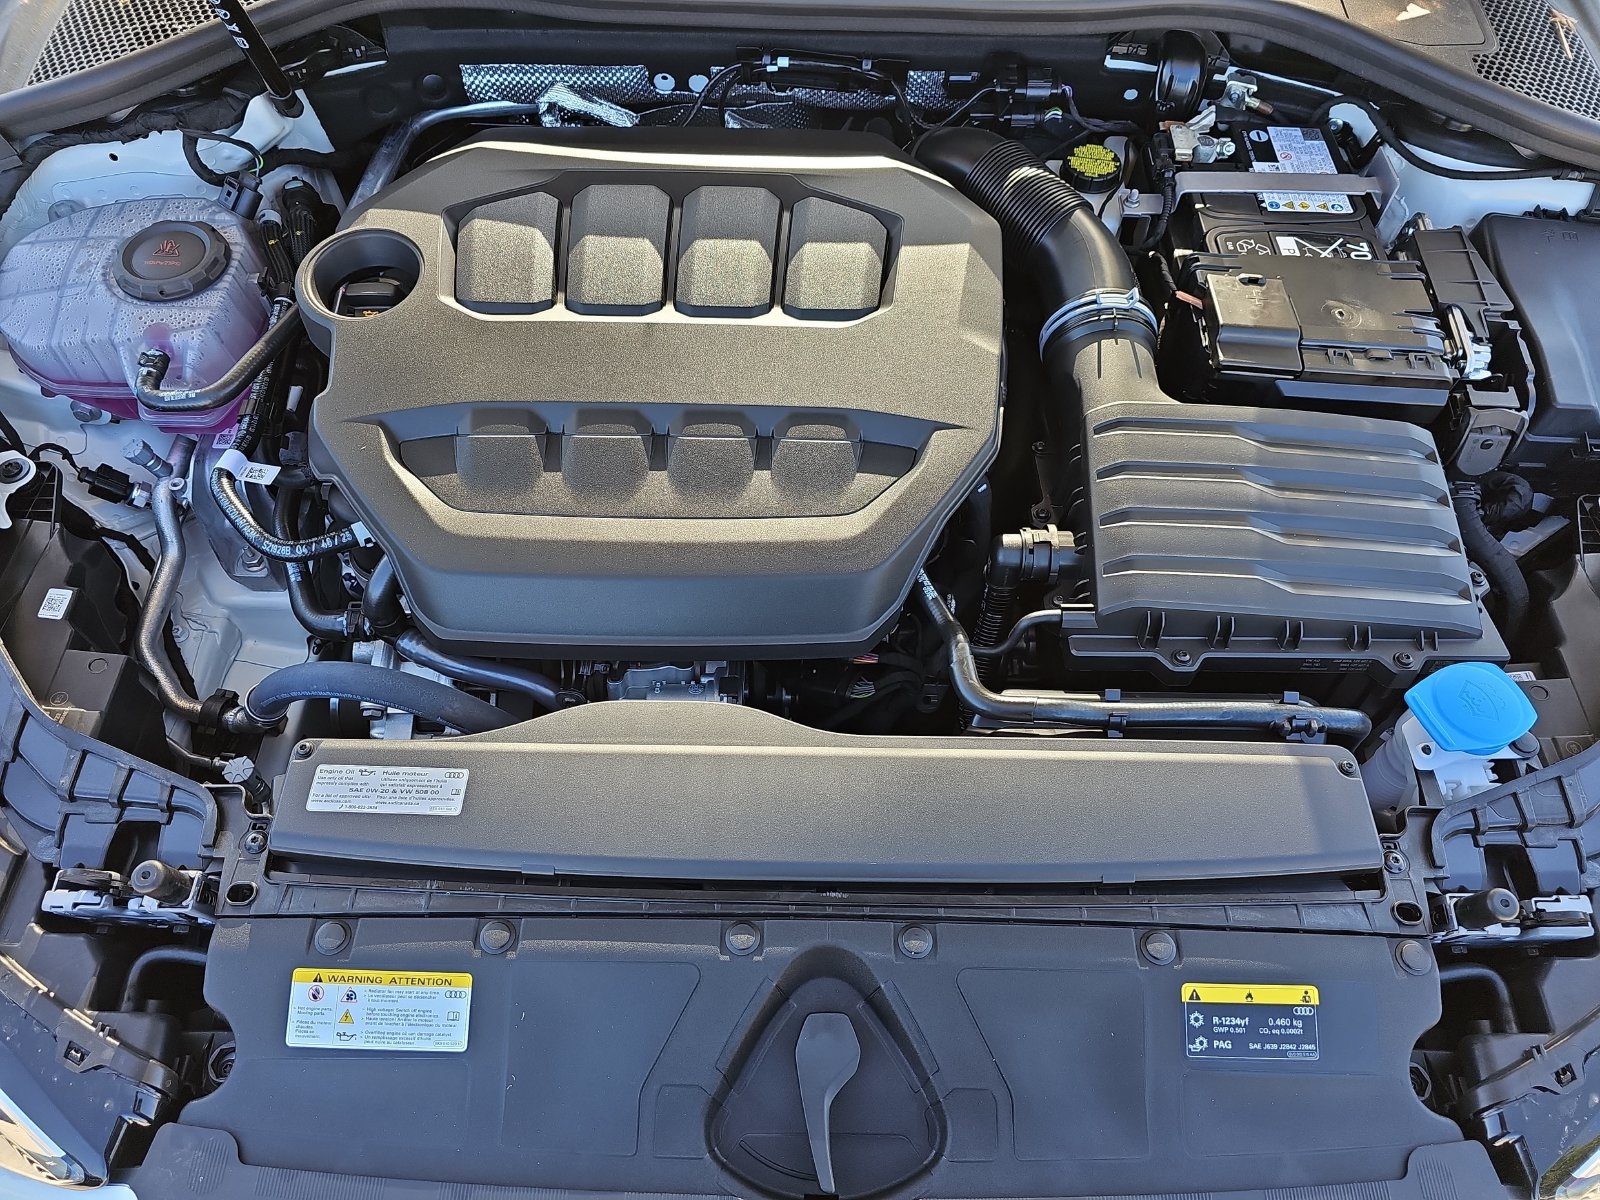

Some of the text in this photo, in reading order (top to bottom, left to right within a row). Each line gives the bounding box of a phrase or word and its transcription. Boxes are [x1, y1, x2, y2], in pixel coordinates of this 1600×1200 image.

[328, 975, 453, 986] WARNING ATTENTION
[1213, 1017, 1250, 1026] R-1234yf
[1293, 1018, 1303, 1028] kg
[1214, 1040, 1232, 1049] PAG
